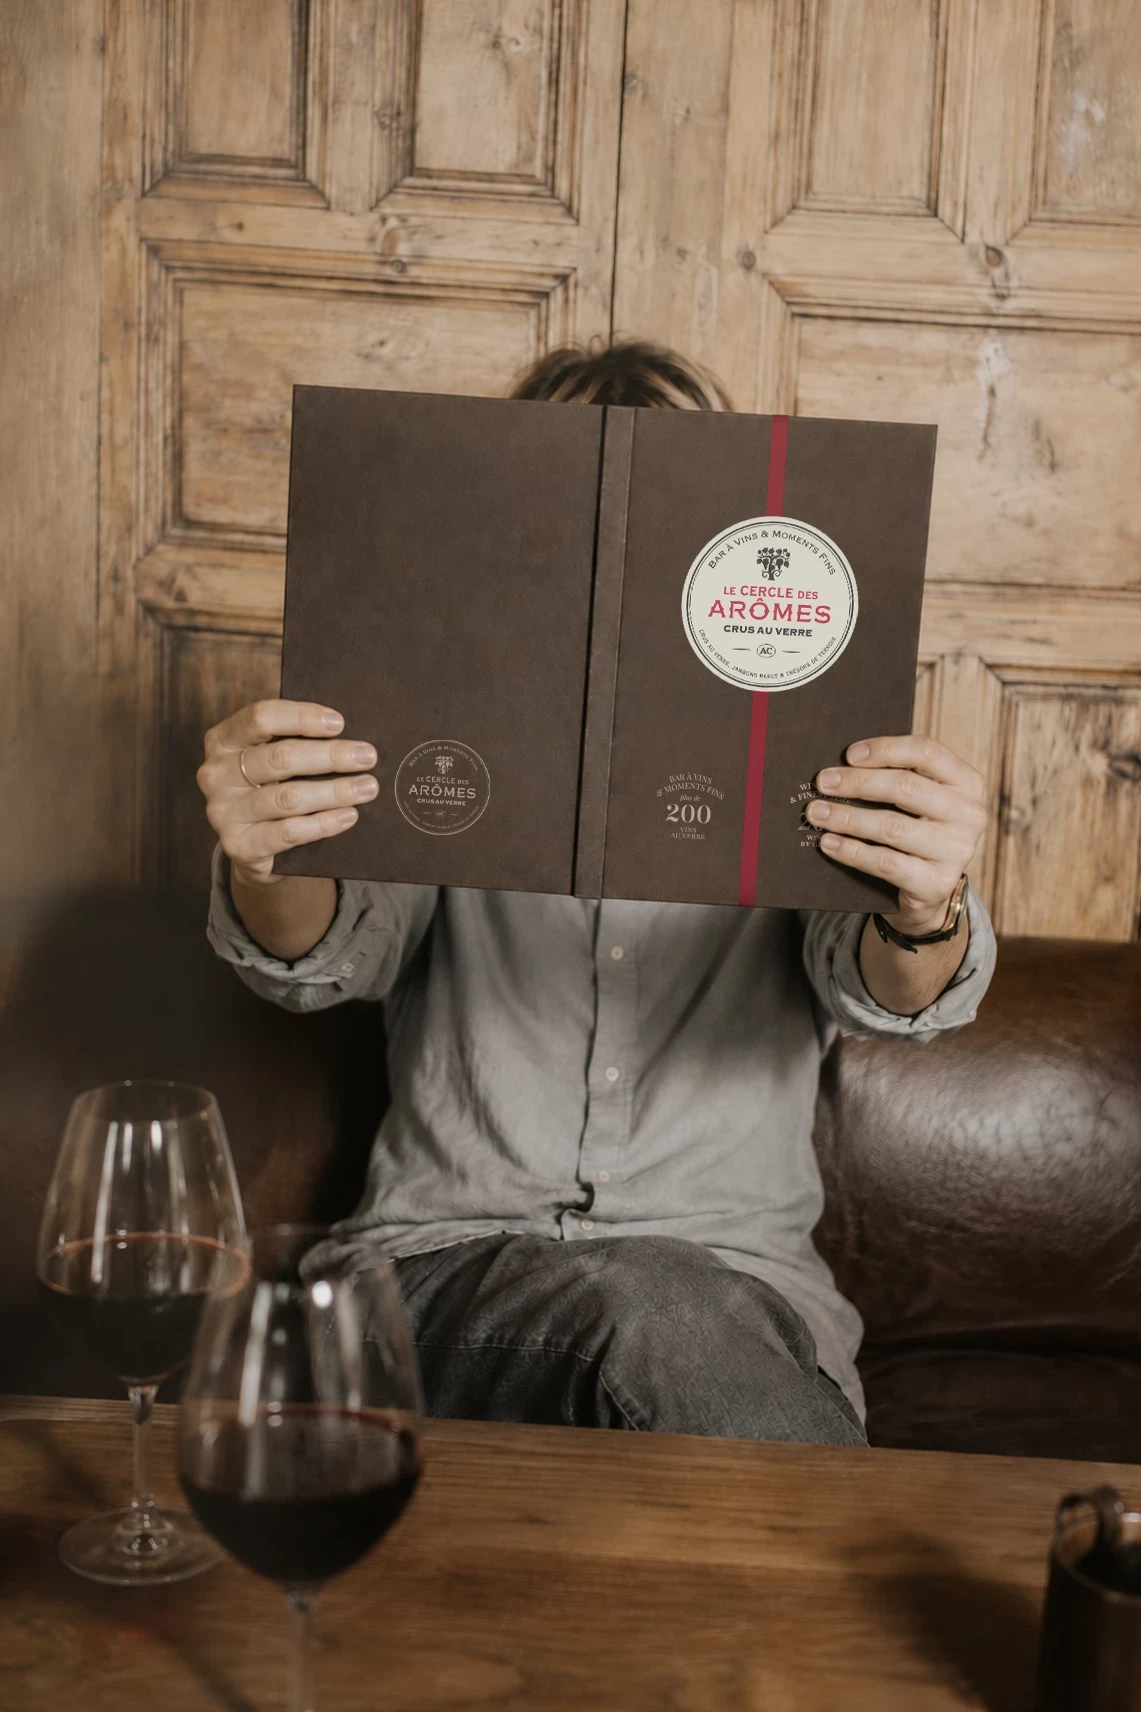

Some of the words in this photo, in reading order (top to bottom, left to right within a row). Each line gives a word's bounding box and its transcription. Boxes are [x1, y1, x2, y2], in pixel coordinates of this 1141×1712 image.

[708, 550, 726, 569] BAR
[726, 543, 734, 552] À
[734, 532, 758, 546] VINS
[761, 530, 768, 538] &
[772, 530, 820, 554] MOMENTS
[818, 553, 836, 576] FINS
[724, 586, 736, 596] LE
[740, 585, 794, 599] CERCLE
[798, 590, 818, 600] DES
[708, 598, 831, 624] ARÔMES
[724, 624, 755, 634] CRUS
[757, 626, 773, 634] AU
[776, 628, 813, 637] VERRE
[698, 629, 709, 644] CRUS
[708, 644, 716, 652] AU
[811, 656, 819, 664] DE
[426, 776, 456, 784] CERCLE
[669, 774, 685, 783] BAR
[686, 772, 692, 780] À
[694, 774, 713, 784] VINS
[800, 782, 817, 790] WIN
[408, 783, 476, 799] ARÔMES
[664, 782, 706, 793] MOMENTS
[706, 786, 725, 800] FINS
[666, 804, 711, 824] 200
